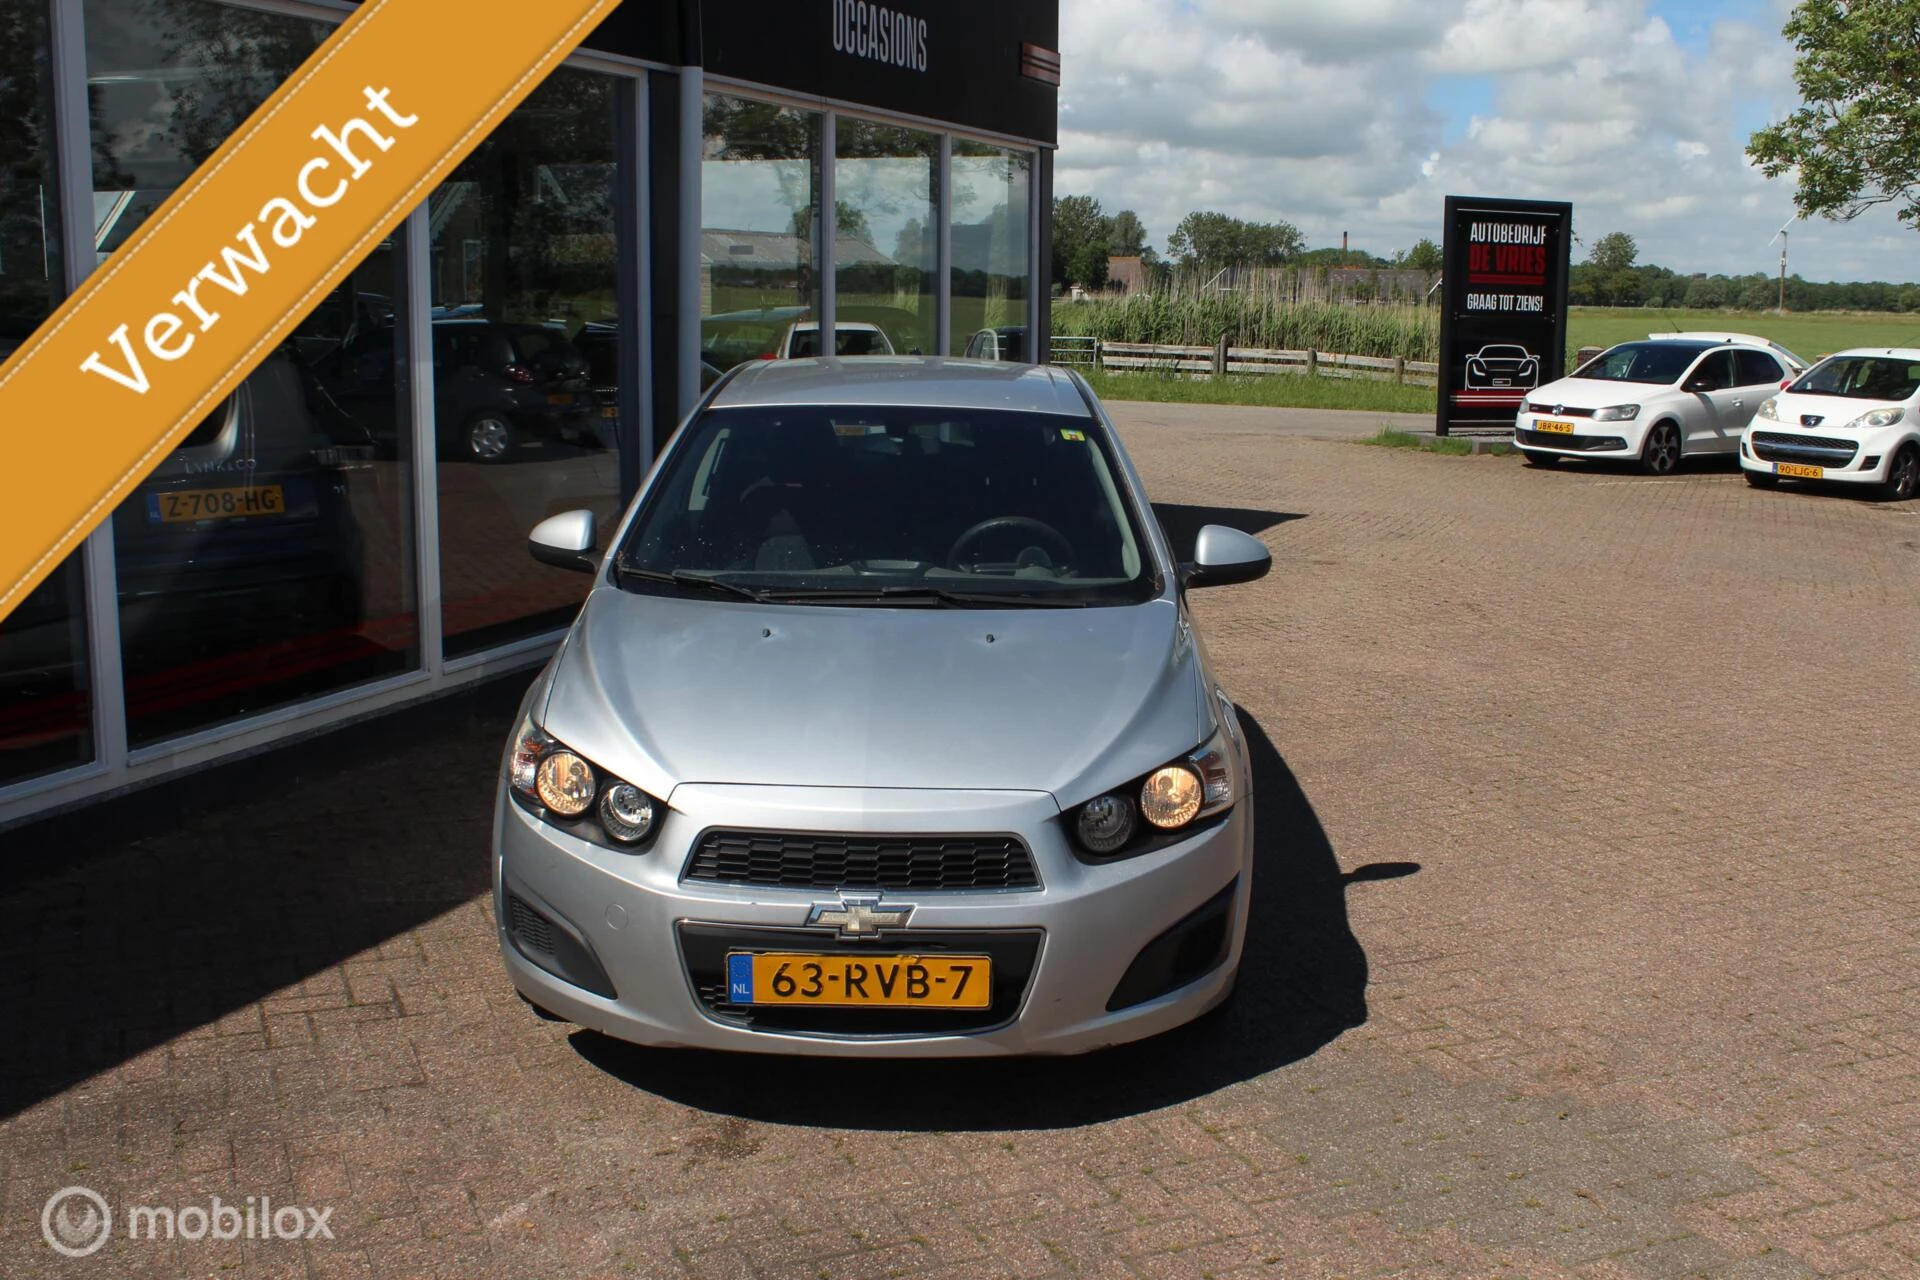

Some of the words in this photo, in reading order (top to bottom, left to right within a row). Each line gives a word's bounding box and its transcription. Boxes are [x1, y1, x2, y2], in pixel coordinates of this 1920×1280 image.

[833, 0, 927, 72] OCCASIONS
[1470, 222, 1547, 245] AUTOBEDRIJF
[1469, 244, 1489, 271] DE
[1495, 245, 1546, 273] VRIES
[1467, 293, 1497, 311] GRAAG
[1499, 294, 1515, 311] TOT
[1516, 295, 1543, 312] ZIENS!
[1779, 464, 1818, 477] 90-LJG-6
[732, 982, 750, 995] NL
[771, 962, 974, 1001] 63-RVB-7
